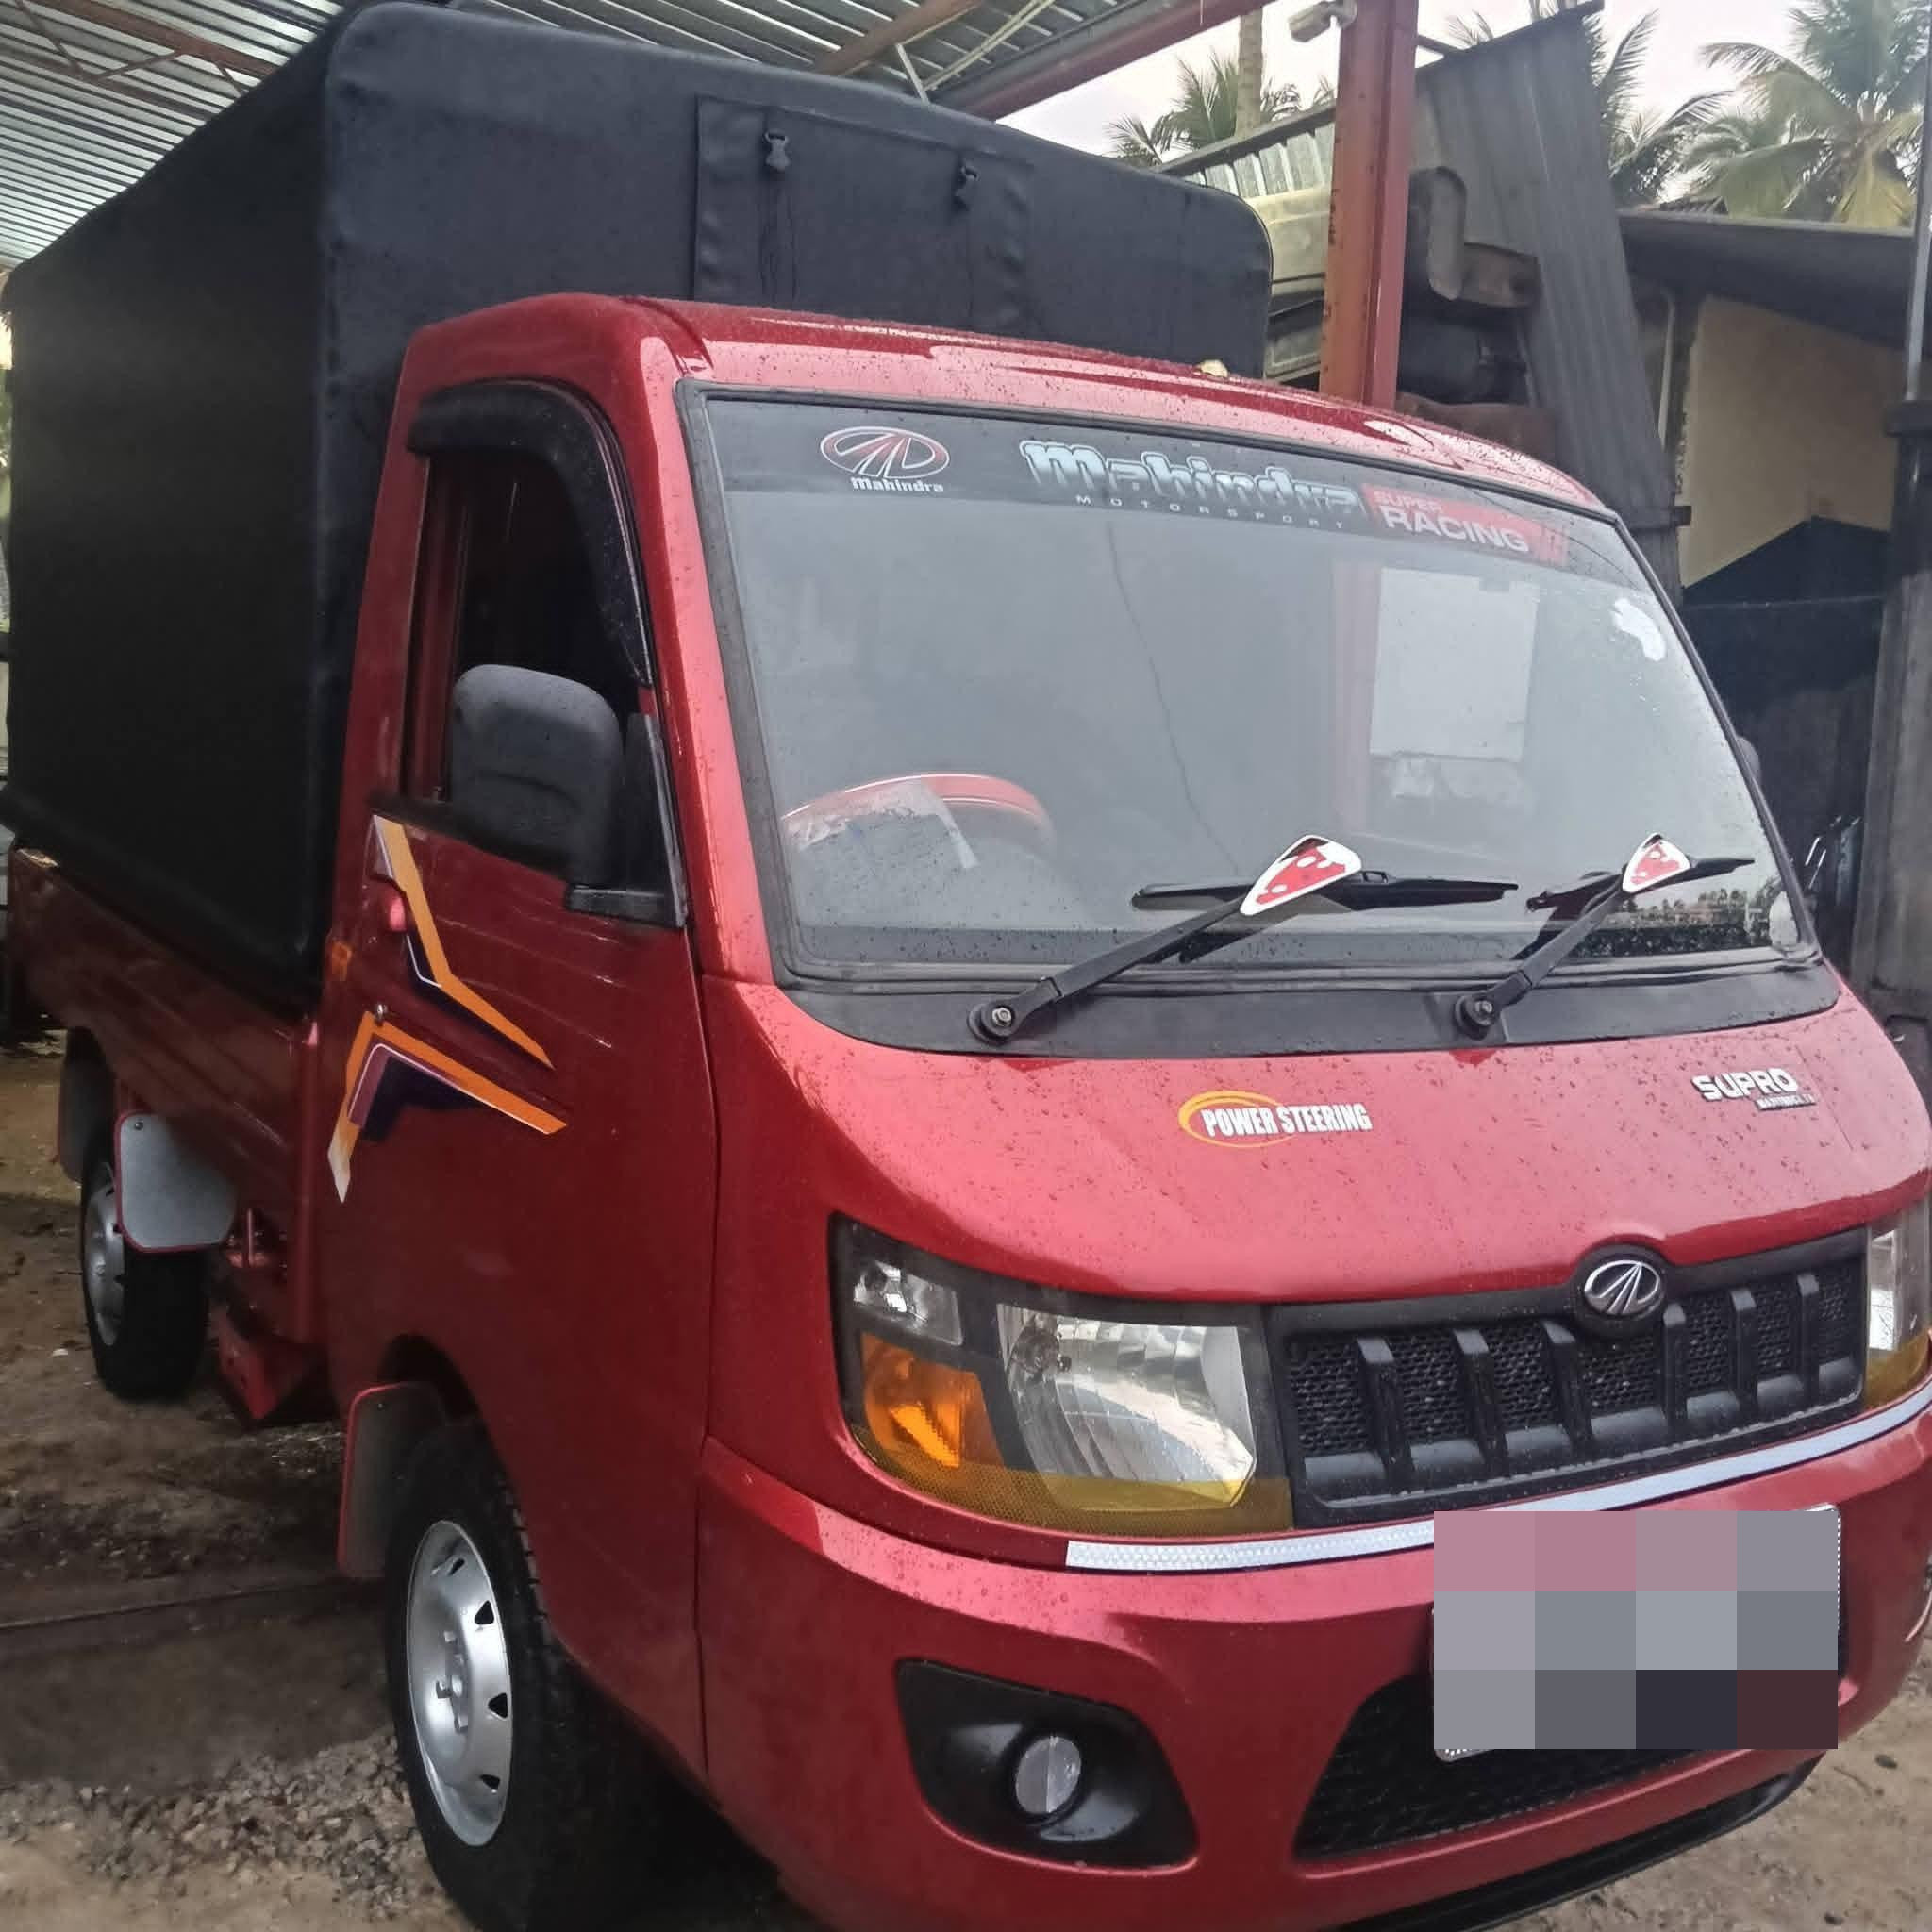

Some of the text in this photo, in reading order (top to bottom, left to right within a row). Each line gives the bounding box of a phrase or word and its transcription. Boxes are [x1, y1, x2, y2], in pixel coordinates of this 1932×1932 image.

[850, 476, 944, 493] Mahindra
[1019, 440, 1367, 515] Mahindra
[1373, 491, 1443, 513] SUPER
[1379, 504, 1530, 553] RACING
[1690, 1067, 1799, 1102] SUPRO
[1200, 1102, 1374, 1138] POWER STEERING
